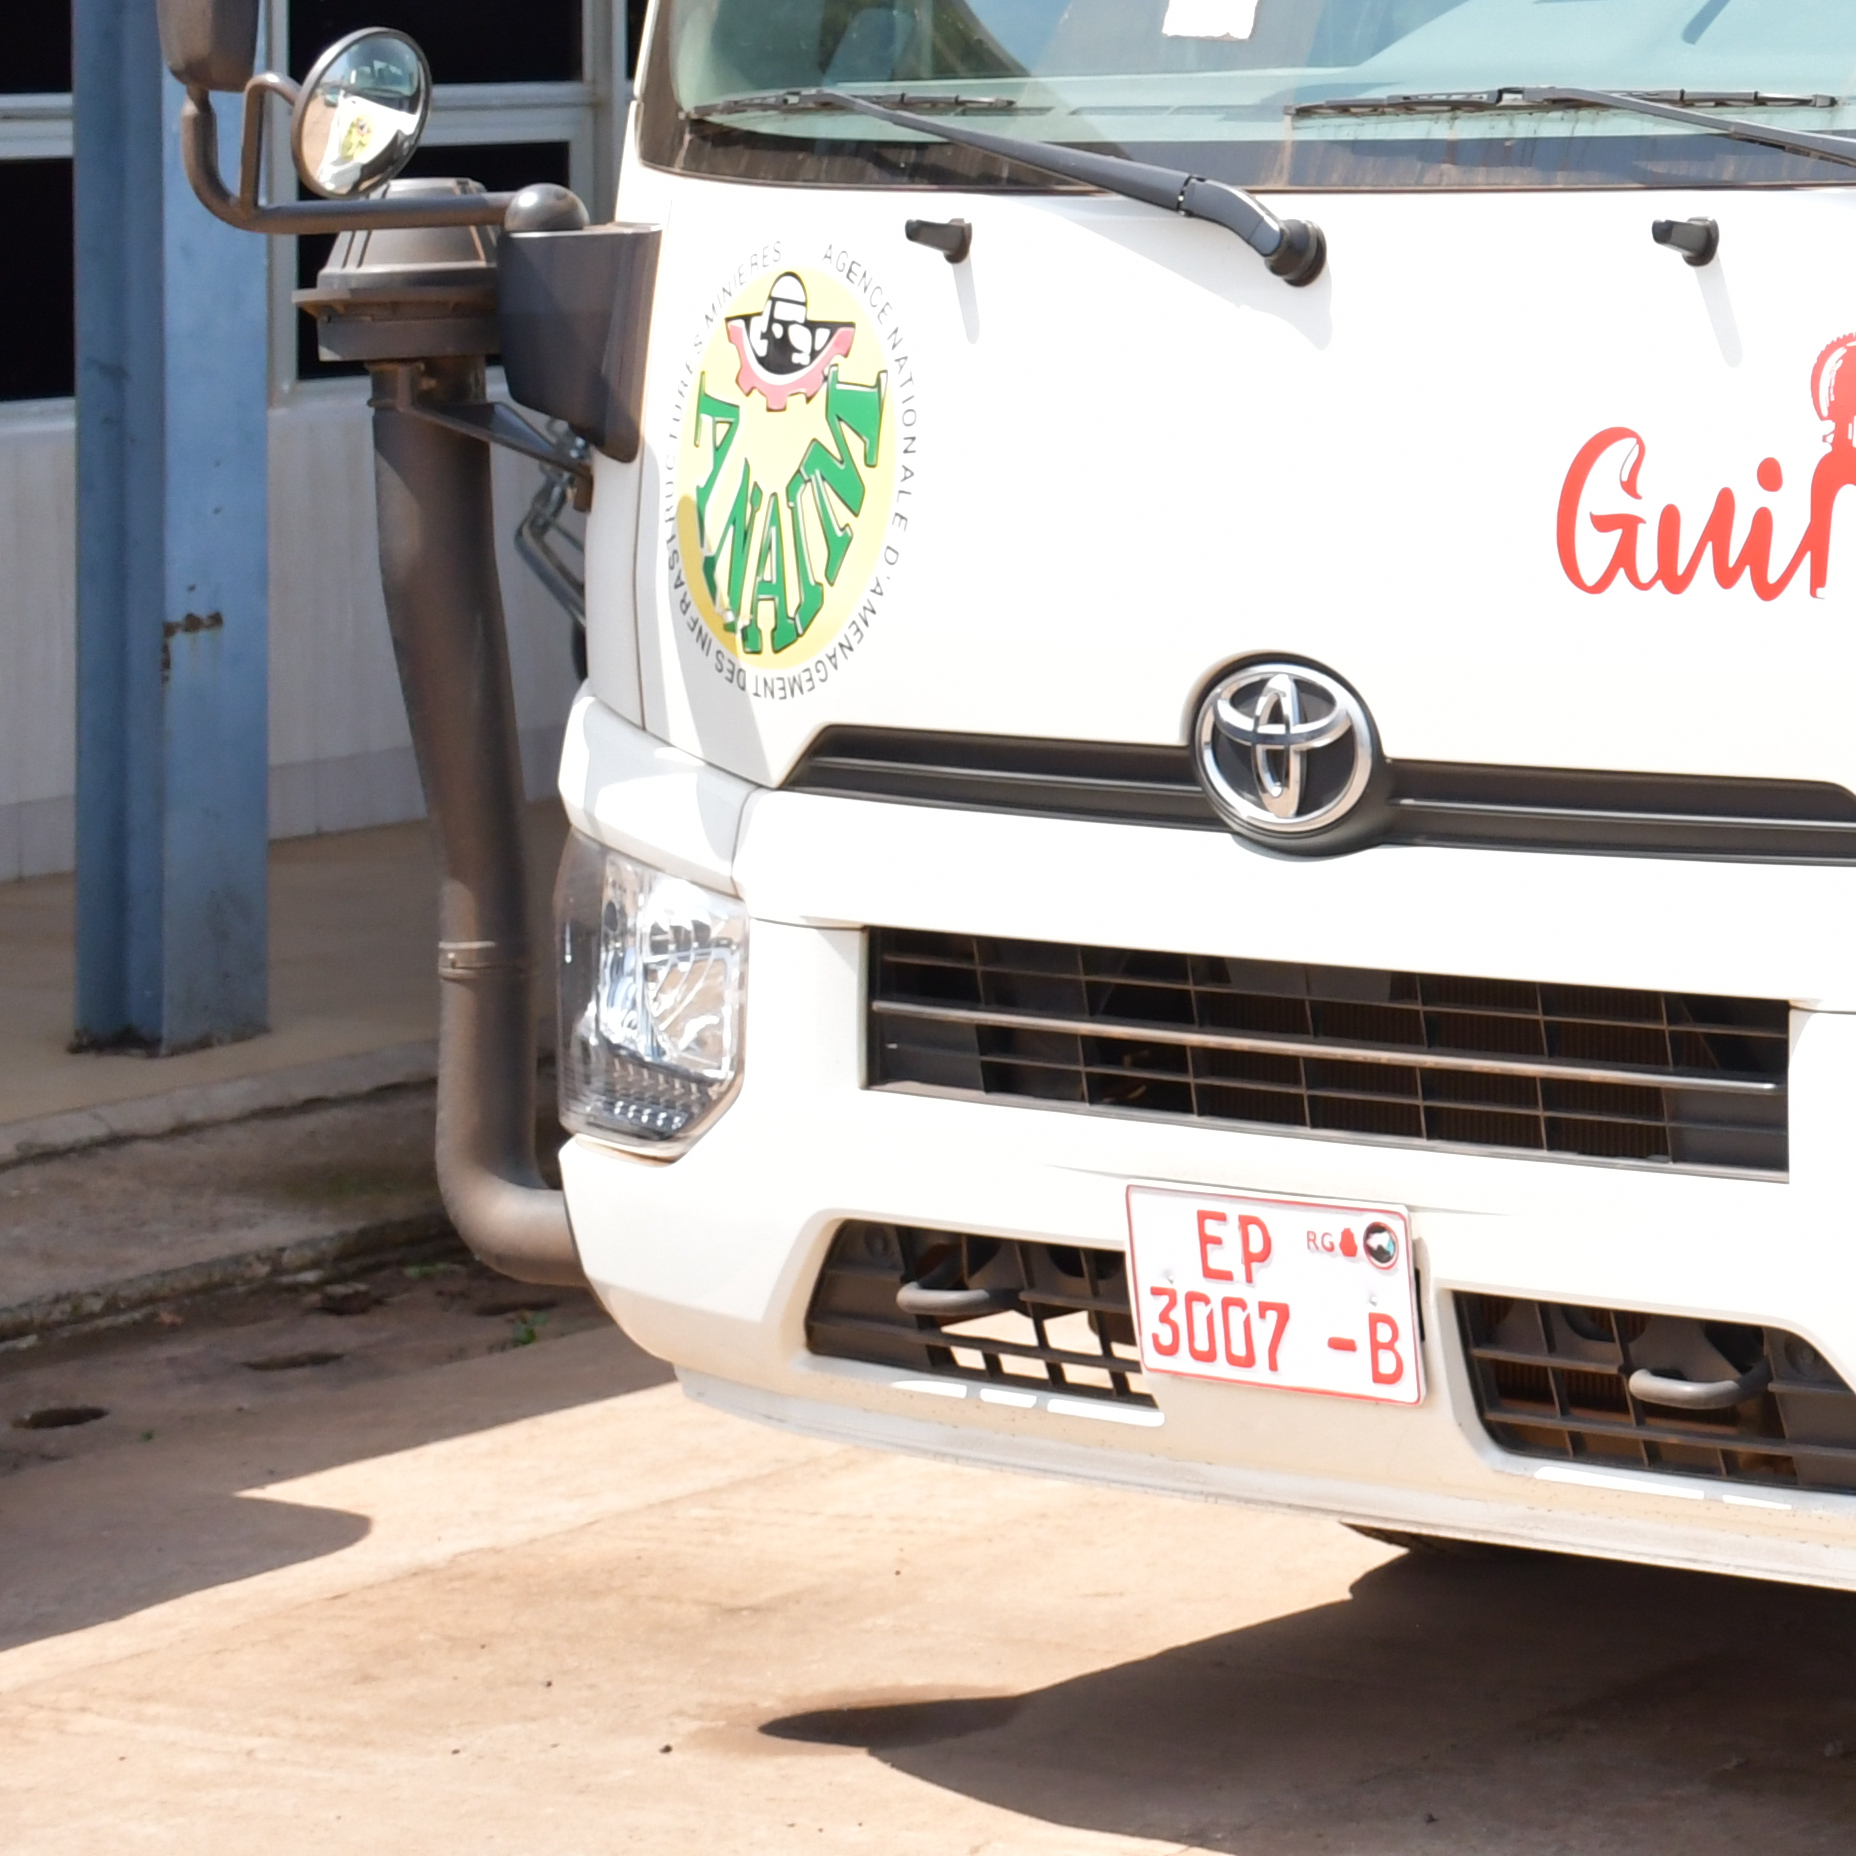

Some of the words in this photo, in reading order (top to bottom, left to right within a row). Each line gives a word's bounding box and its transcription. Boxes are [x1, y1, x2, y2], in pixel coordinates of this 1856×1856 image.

[704, 241, 782, 328] MINIERES
[822, 243, 894, 326] AGENCE
[889, 325, 918, 534] NATIONALE
[714, 650, 746, 693] DES
[1196, 1209, 1273, 1284] EP
[1307, 1230, 1335, 1253] RG
[1150, 1285, 1291, 1372] 3007
